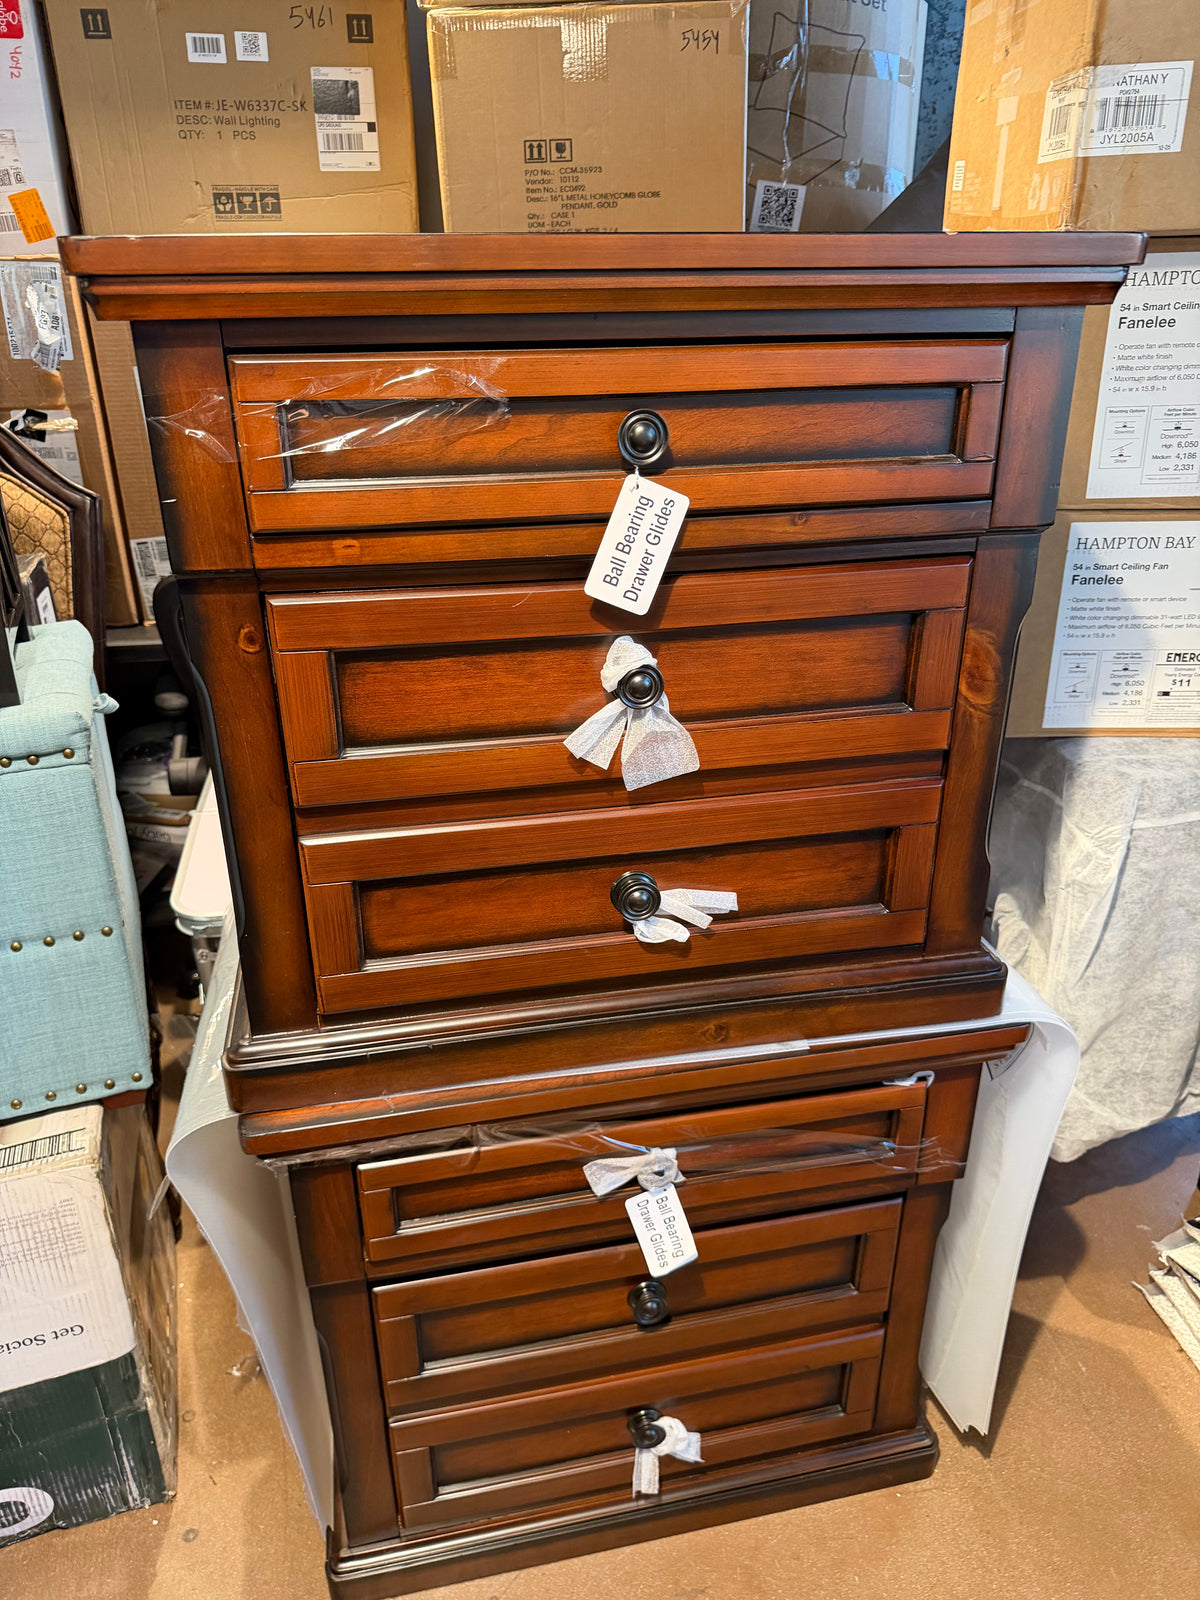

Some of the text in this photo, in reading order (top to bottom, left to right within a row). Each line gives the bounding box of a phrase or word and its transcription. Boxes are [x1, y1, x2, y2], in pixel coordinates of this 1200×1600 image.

[289, 6, 333, 29] 5461
[680, 28, 719, 54] 5454
[1113, 74, 1158, 86] ATHAN
[174, 100, 201, 110] ITEM
[216, 100, 308, 112] JE-W6337C-SK
[176, 115, 280, 128] DESC: Wall Lighting
[178, 130, 256, 140] QTY: 1 PCS
[1100, 132, 1154, 144] JYL2005A
[525, 169, 539, 177] P/O
[590, 192, 636, 200] HONEYCOMB
[1142, 302, 1171, 311] Smart
[1173, 301, 1200, 310] Ceilin
[1118, 316, 1176, 329] Fanelee
[603, 496, 654, 587] Ball Bearing
[1076, 536, 1196, 550] HAMPTON BAY
[623, 498, 675, 602] Drawer Glides
[1121, 563, 1150, 571] Ceiling
[1072, 575, 1124, 585] Fanelee
[637, 1199, 668, 1268] Drawer Glides
[656, 1196, 684, 1258] Ball Bearing
[51, 1325, 84, 1340] Get
